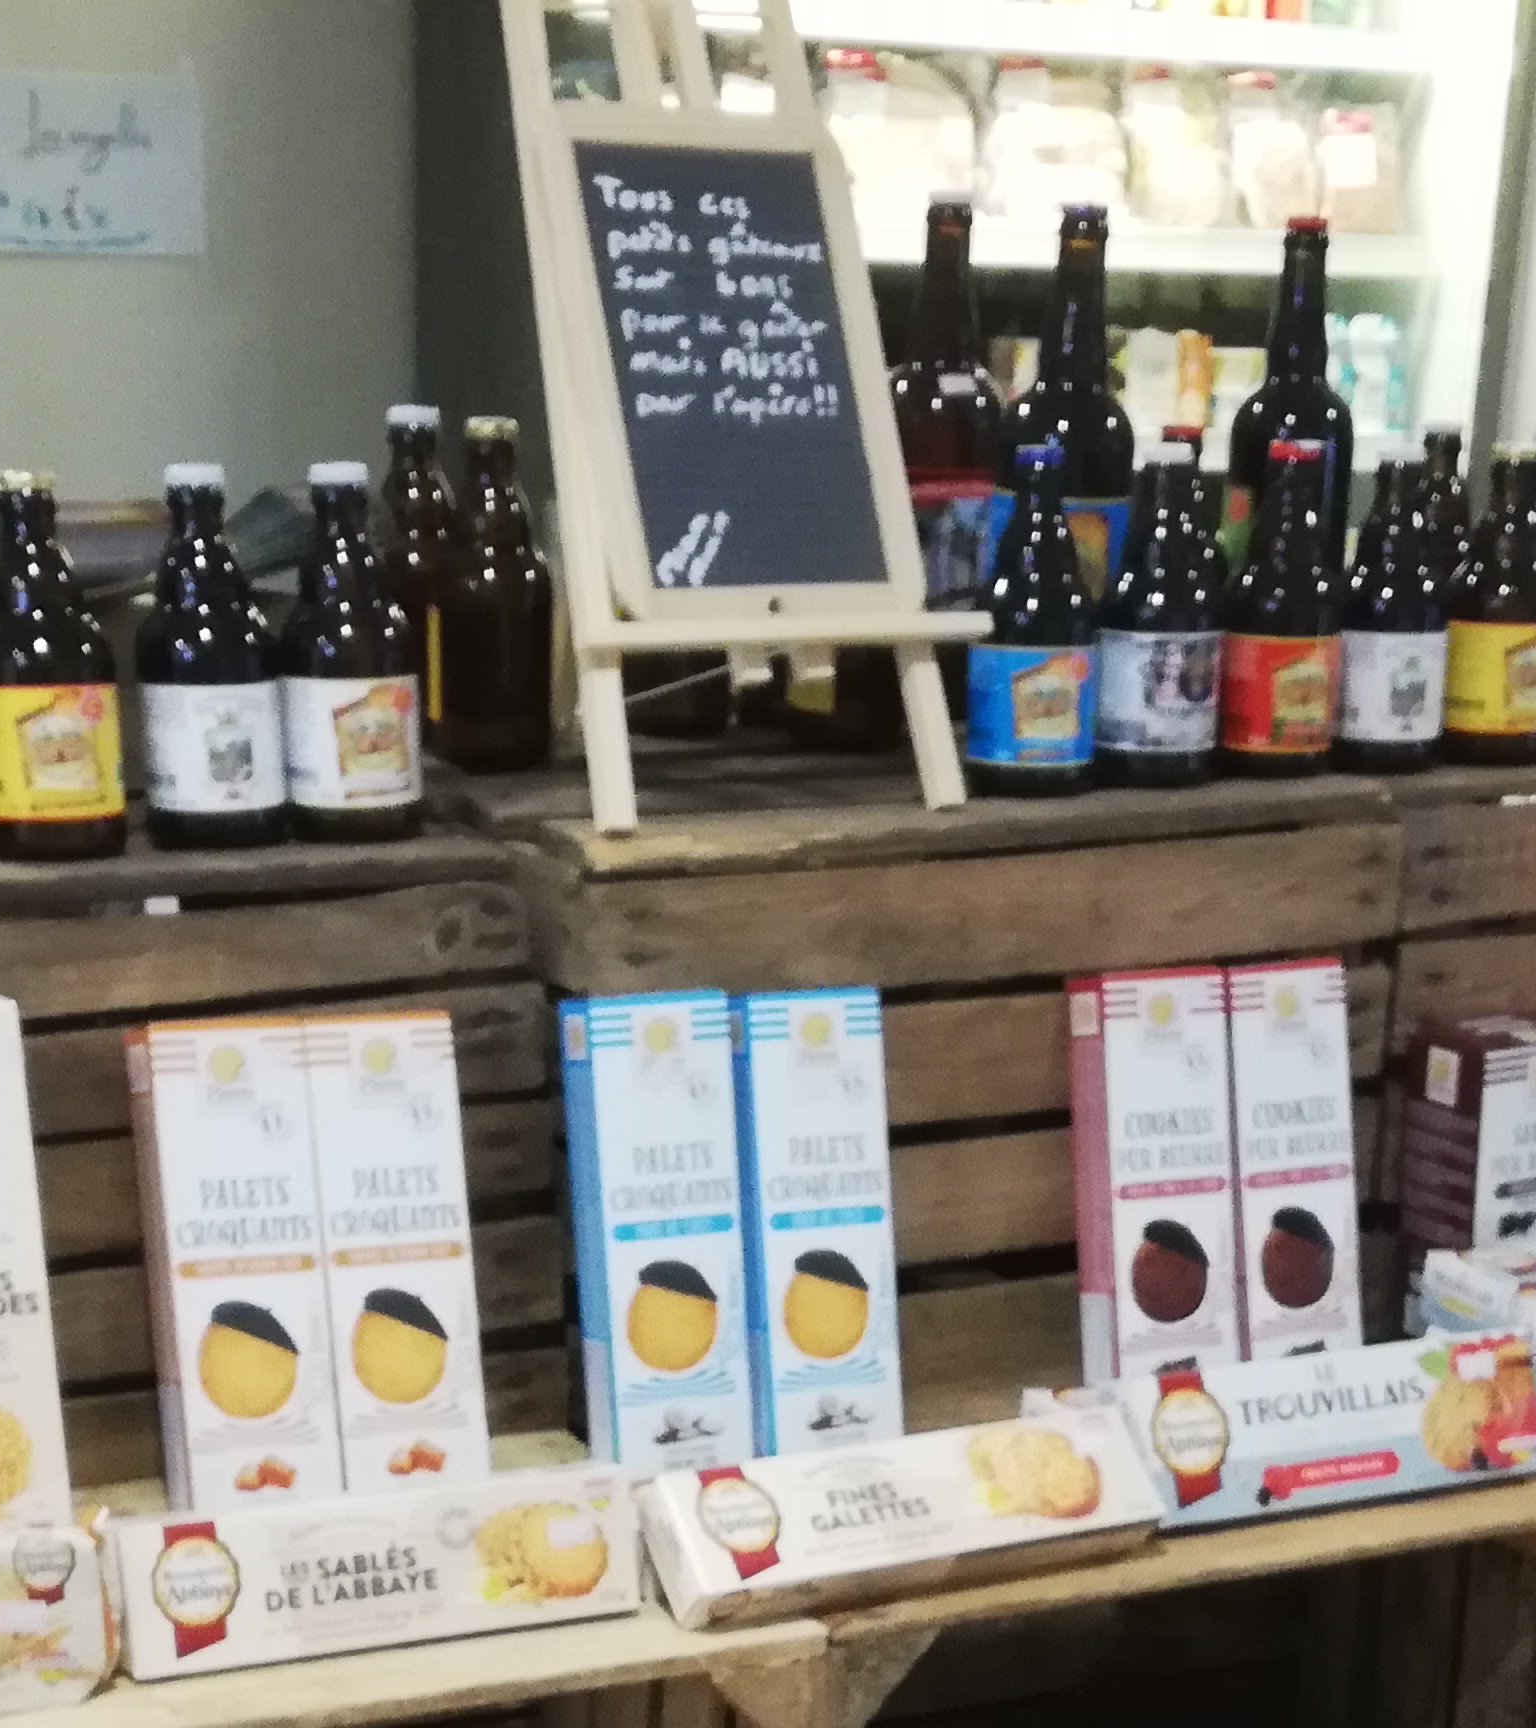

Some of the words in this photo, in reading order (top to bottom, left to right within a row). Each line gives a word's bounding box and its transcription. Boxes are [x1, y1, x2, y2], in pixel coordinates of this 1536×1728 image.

[592, 173, 675, 213] Tous
[199, 1175, 290, 1210] PALETS
[352, 1165, 440, 1199] PALETS
[1240, 1376, 1426, 1425] TROUVILLAIS
[826, 1481, 897, 1508] FINES
[811, 1499, 931, 1533] GALETTES
[316, 1545, 416, 1580] SABLÉS
[266, 1589, 305, 1613] DE
[311, 1568, 439, 1607] L'ABBAYE
